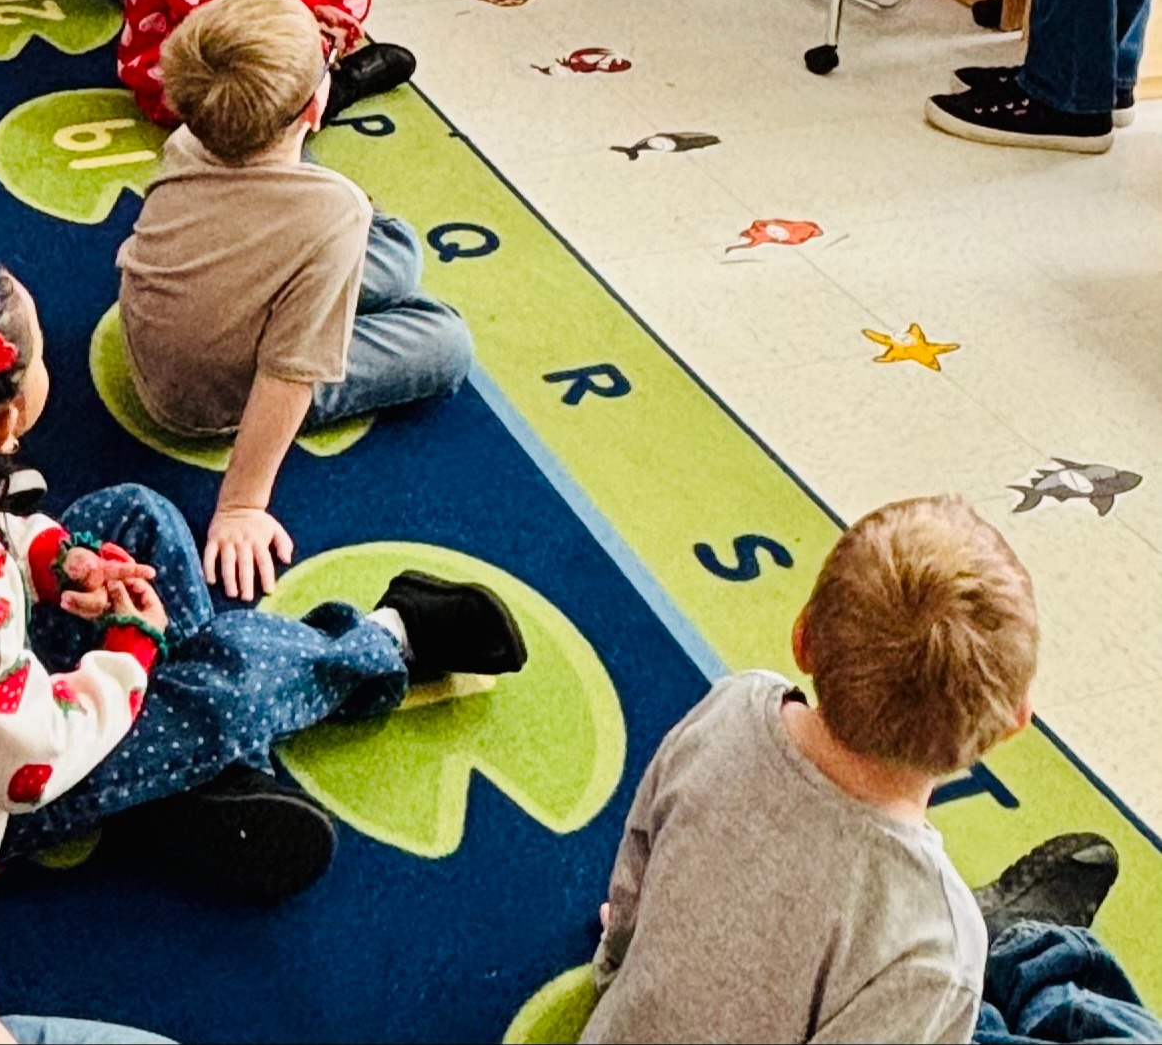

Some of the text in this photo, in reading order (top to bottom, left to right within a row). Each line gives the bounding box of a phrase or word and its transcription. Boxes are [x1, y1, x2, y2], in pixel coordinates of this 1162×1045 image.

[53, 119, 157, 169] 19
[327, 114, 396, 137] P
[426, 222, 500, 263] Q
[542, 363, 631, 405] R
[693, 534, 794, 581] S
